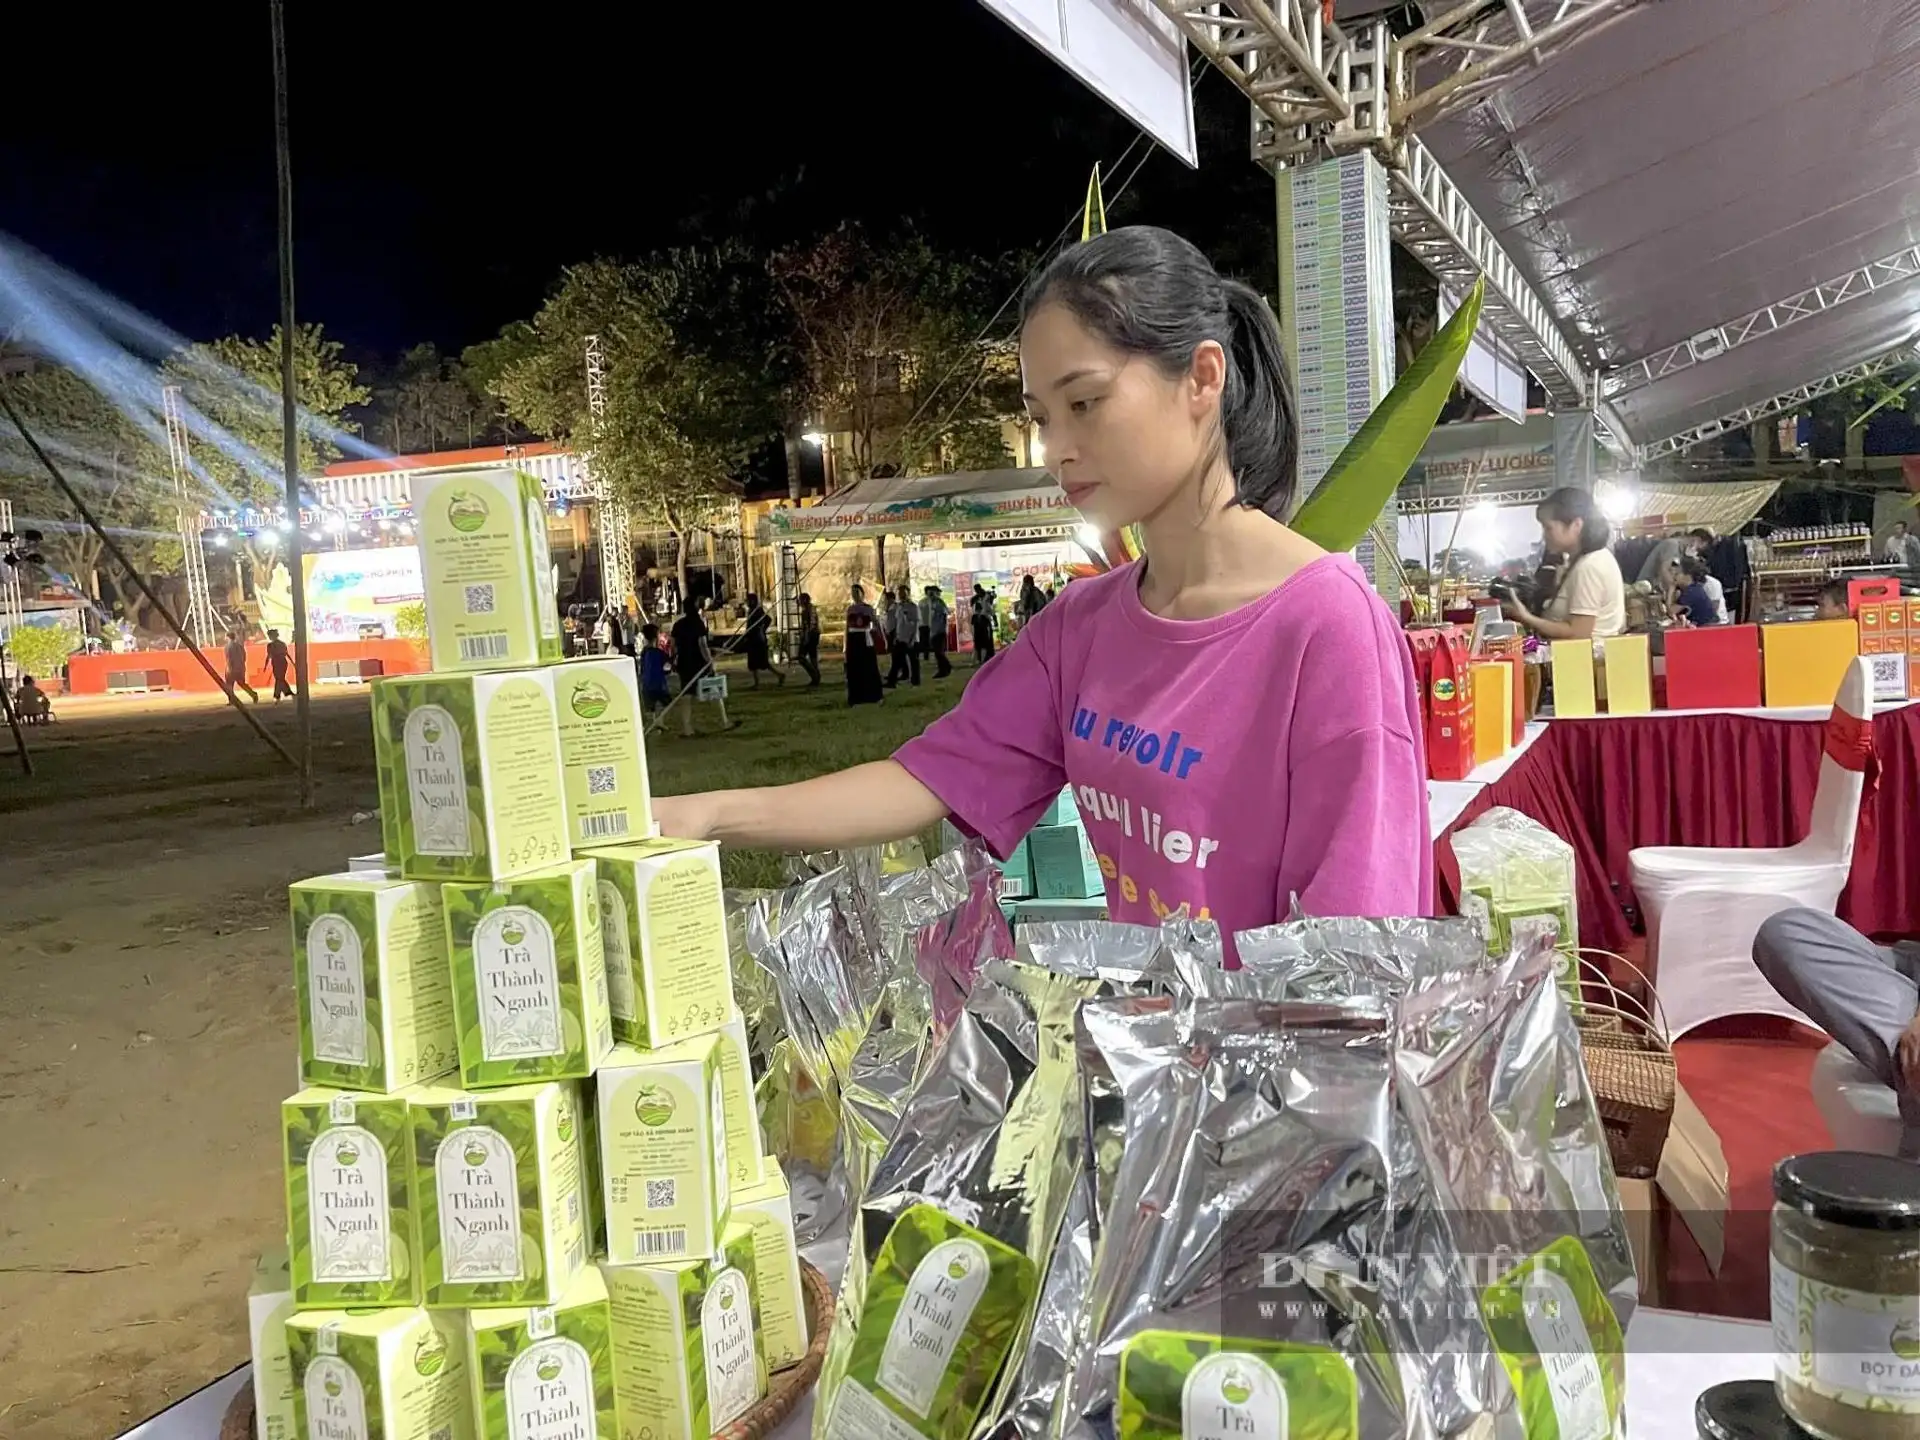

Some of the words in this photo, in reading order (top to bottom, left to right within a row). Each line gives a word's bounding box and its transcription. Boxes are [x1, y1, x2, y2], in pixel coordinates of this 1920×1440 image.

[836, 509, 864, 526] PHỐ
[498, 947, 532, 965] Trà
[487, 968, 545, 989] Thành
[491, 989, 549, 1015] Ngạnh
[331, 1167, 364, 1186] Trà
[460, 1168, 494, 1186] Trà
[319, 1190, 375, 1209] Thành
[448, 1191, 506, 1210] Thành
[323, 1213, 379, 1237] Ngạnh
[453, 1214, 510, 1238] Ngạnh
[932, 1274, 960, 1304] Trà
[718, 1308, 739, 1332] Trà
[913, 1290, 954, 1332] Thành
[711, 1325, 747, 1359] Thành
[533, 1380, 567, 1401] Trà
[520, 1400, 580, 1429] Thành
[1215, 1403, 1255, 1434] Trà
